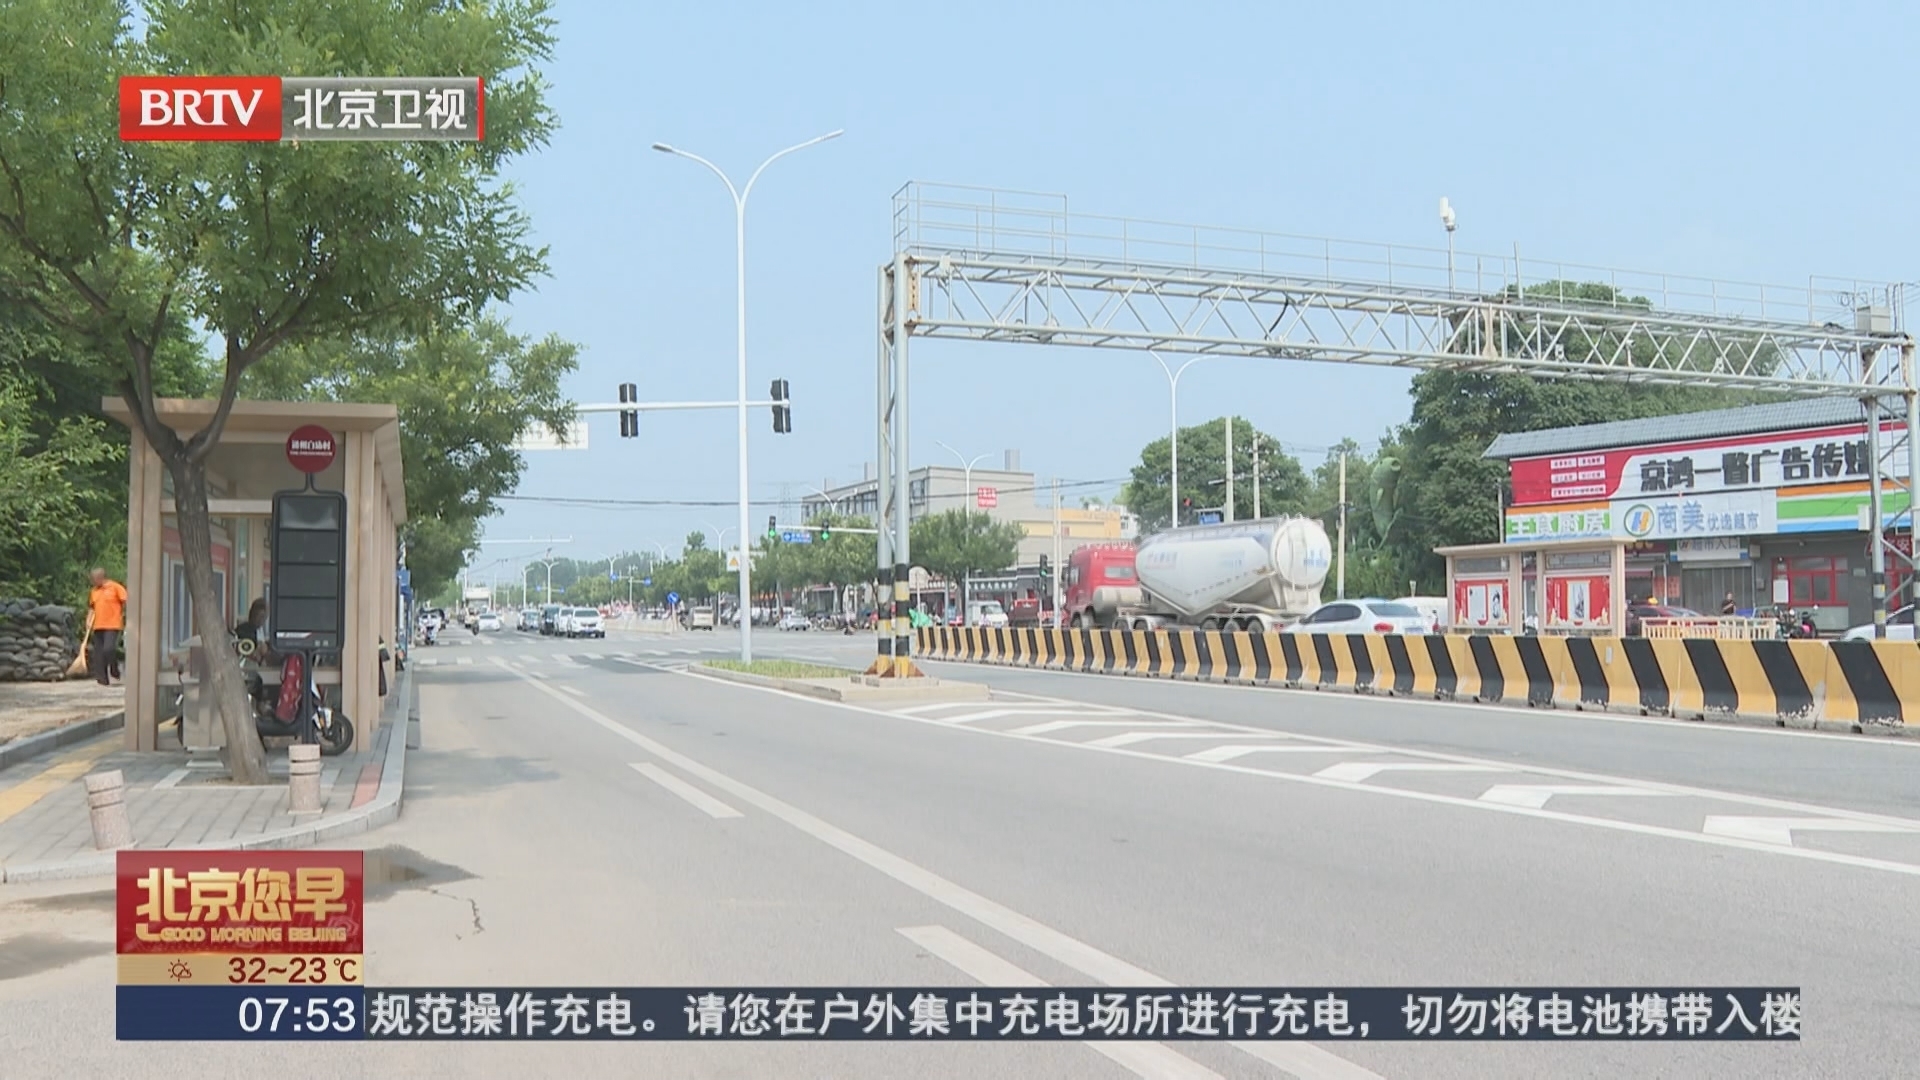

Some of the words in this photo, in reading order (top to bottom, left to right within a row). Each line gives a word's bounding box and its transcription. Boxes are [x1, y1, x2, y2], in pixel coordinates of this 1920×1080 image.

[1640, 440, 1870, 492] 京鸿一瞥广告传媒
